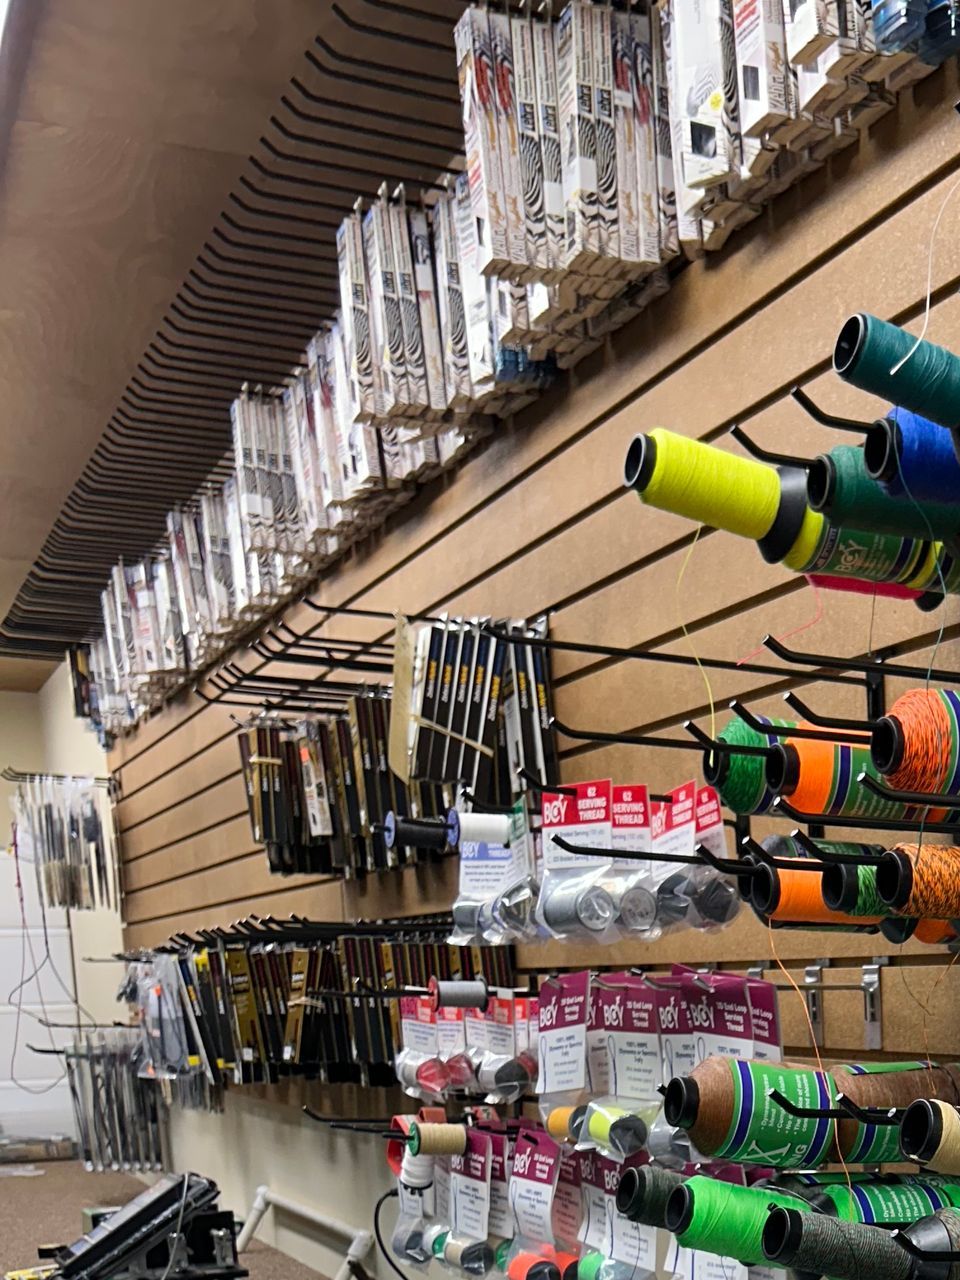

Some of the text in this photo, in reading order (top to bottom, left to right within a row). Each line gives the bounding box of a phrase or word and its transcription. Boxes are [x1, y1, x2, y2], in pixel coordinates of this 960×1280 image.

[577, 797, 606, 809] SERVING
[587, 787, 597, 796] 62
[622, 792, 632, 801] 62
[544, 798, 568, 824] BCY
[579, 809, 605, 821] THREAD
[613, 803, 644, 813] SERVING
[615, 814, 643, 824] THREAD
[652, 806, 666, 836] BCY
[540, 999, 558, 1027] BCY
[604, 999, 624, 1027] BCY
[659, 1001, 678, 1029] BCY
[690, 1000, 715, 1028] BCY
[513, 1150, 531, 1175] BCY
